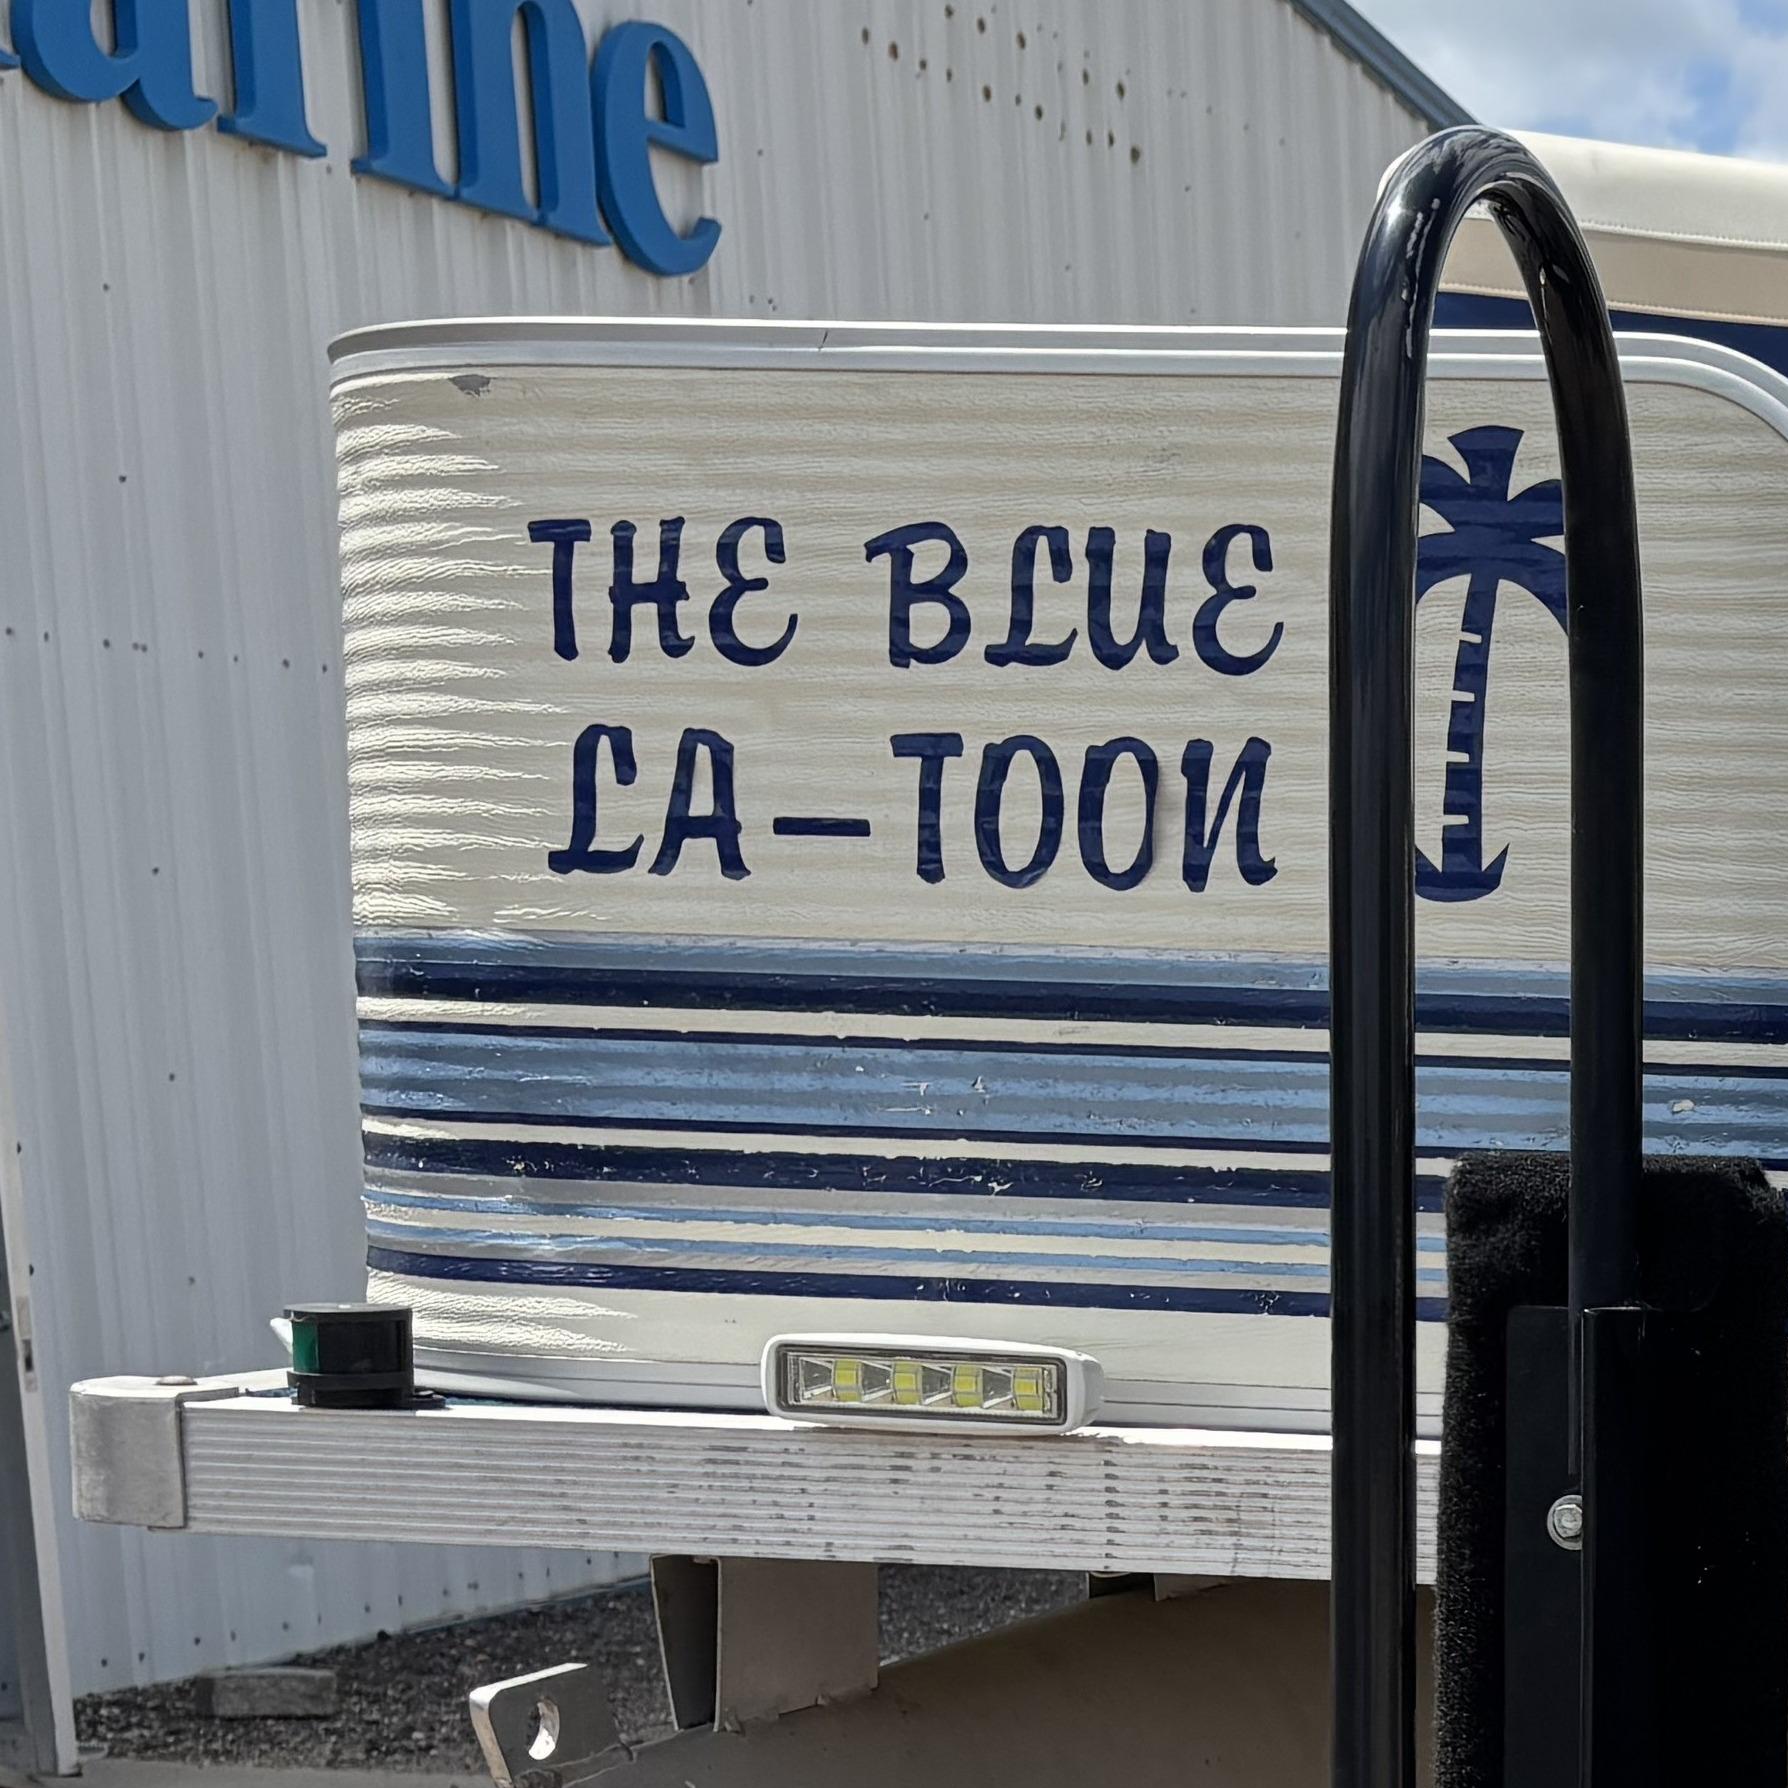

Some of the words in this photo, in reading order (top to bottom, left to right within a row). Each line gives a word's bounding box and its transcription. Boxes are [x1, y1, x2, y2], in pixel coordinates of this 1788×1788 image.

[0, 0, 722, 277] arine
[528, 516, 798, 667] THE
[865, 520, 1285, 676] BLUE
